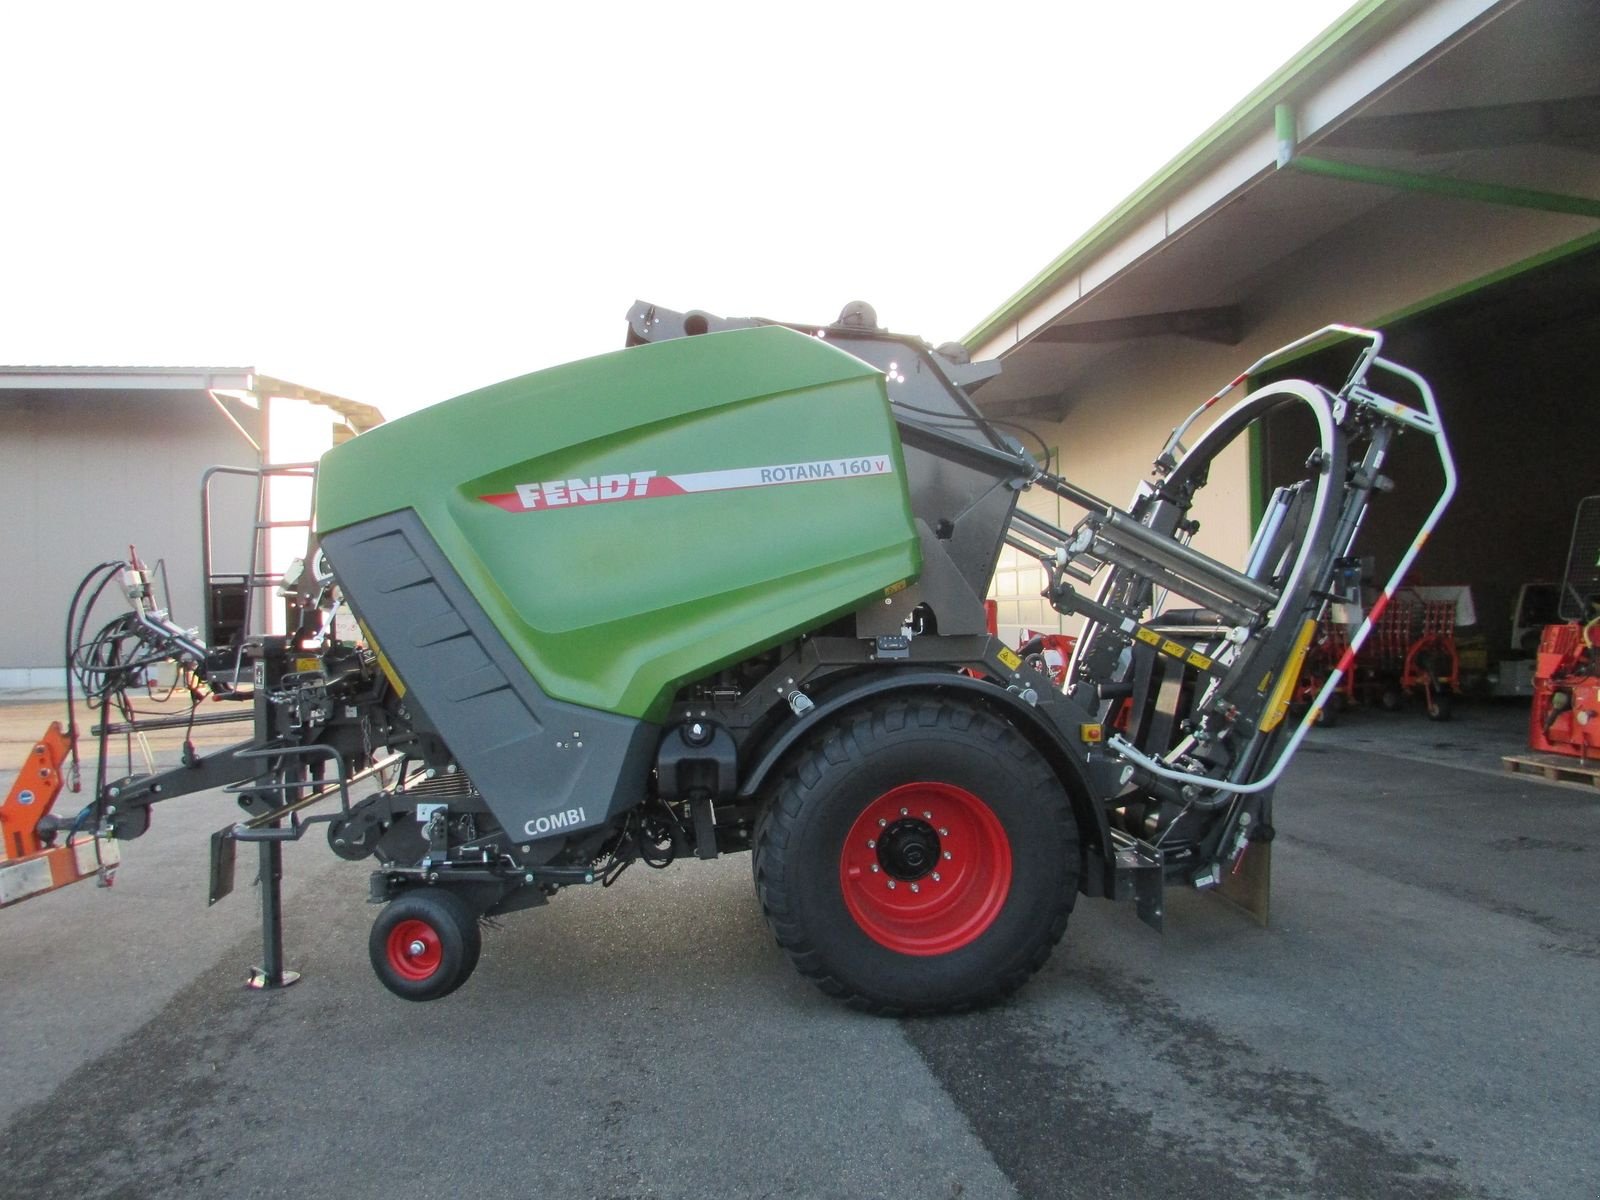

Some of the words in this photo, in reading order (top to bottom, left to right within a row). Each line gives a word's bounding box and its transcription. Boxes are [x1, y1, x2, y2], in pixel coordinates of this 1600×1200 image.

[760, 463, 835, 483] ROTANA
[840, 459, 871, 475] 160
[514, 470, 657, 508] FENDT
[524, 807, 586, 836] COMBI
